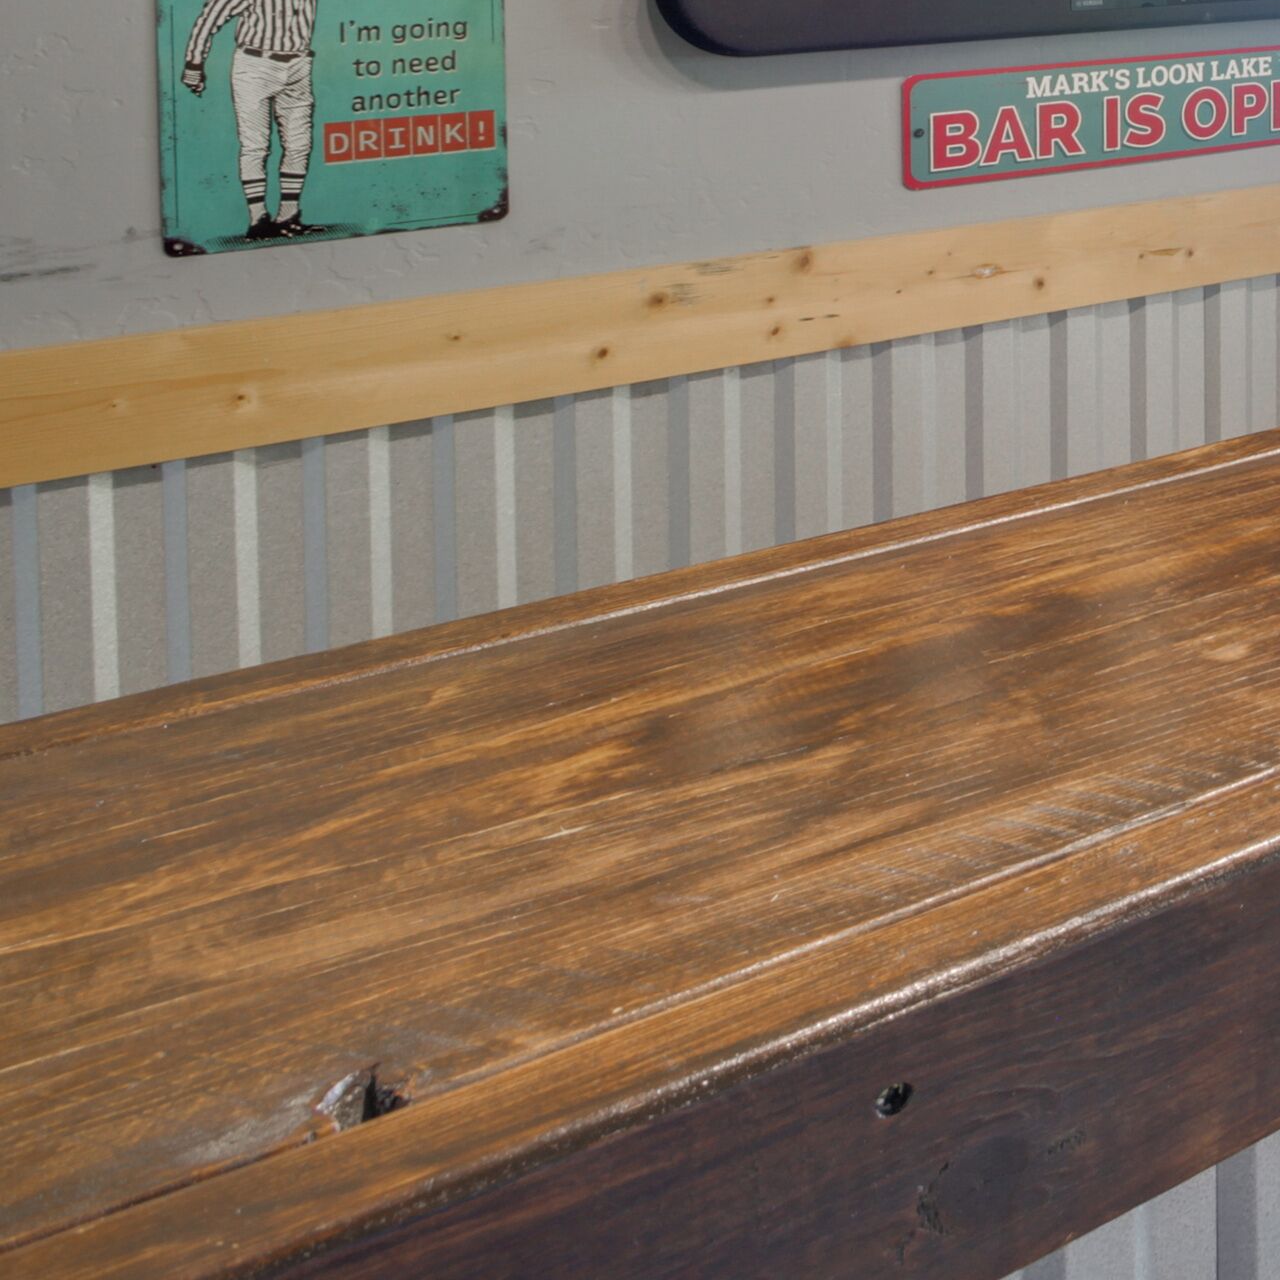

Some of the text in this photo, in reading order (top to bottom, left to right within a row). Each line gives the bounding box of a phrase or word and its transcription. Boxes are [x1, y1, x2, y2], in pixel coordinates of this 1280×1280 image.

[339, 18, 469, 44] I'm going
[352, 51, 457, 78] to need
[1026, 55, 1273, 99] MARK'S LOON LAKE
[351, 86, 461, 113] another
[328, 121, 488, 156] DRINK!
[929, 99, 1086, 173] BAR
[1103, 91, 1167, 152] IS
